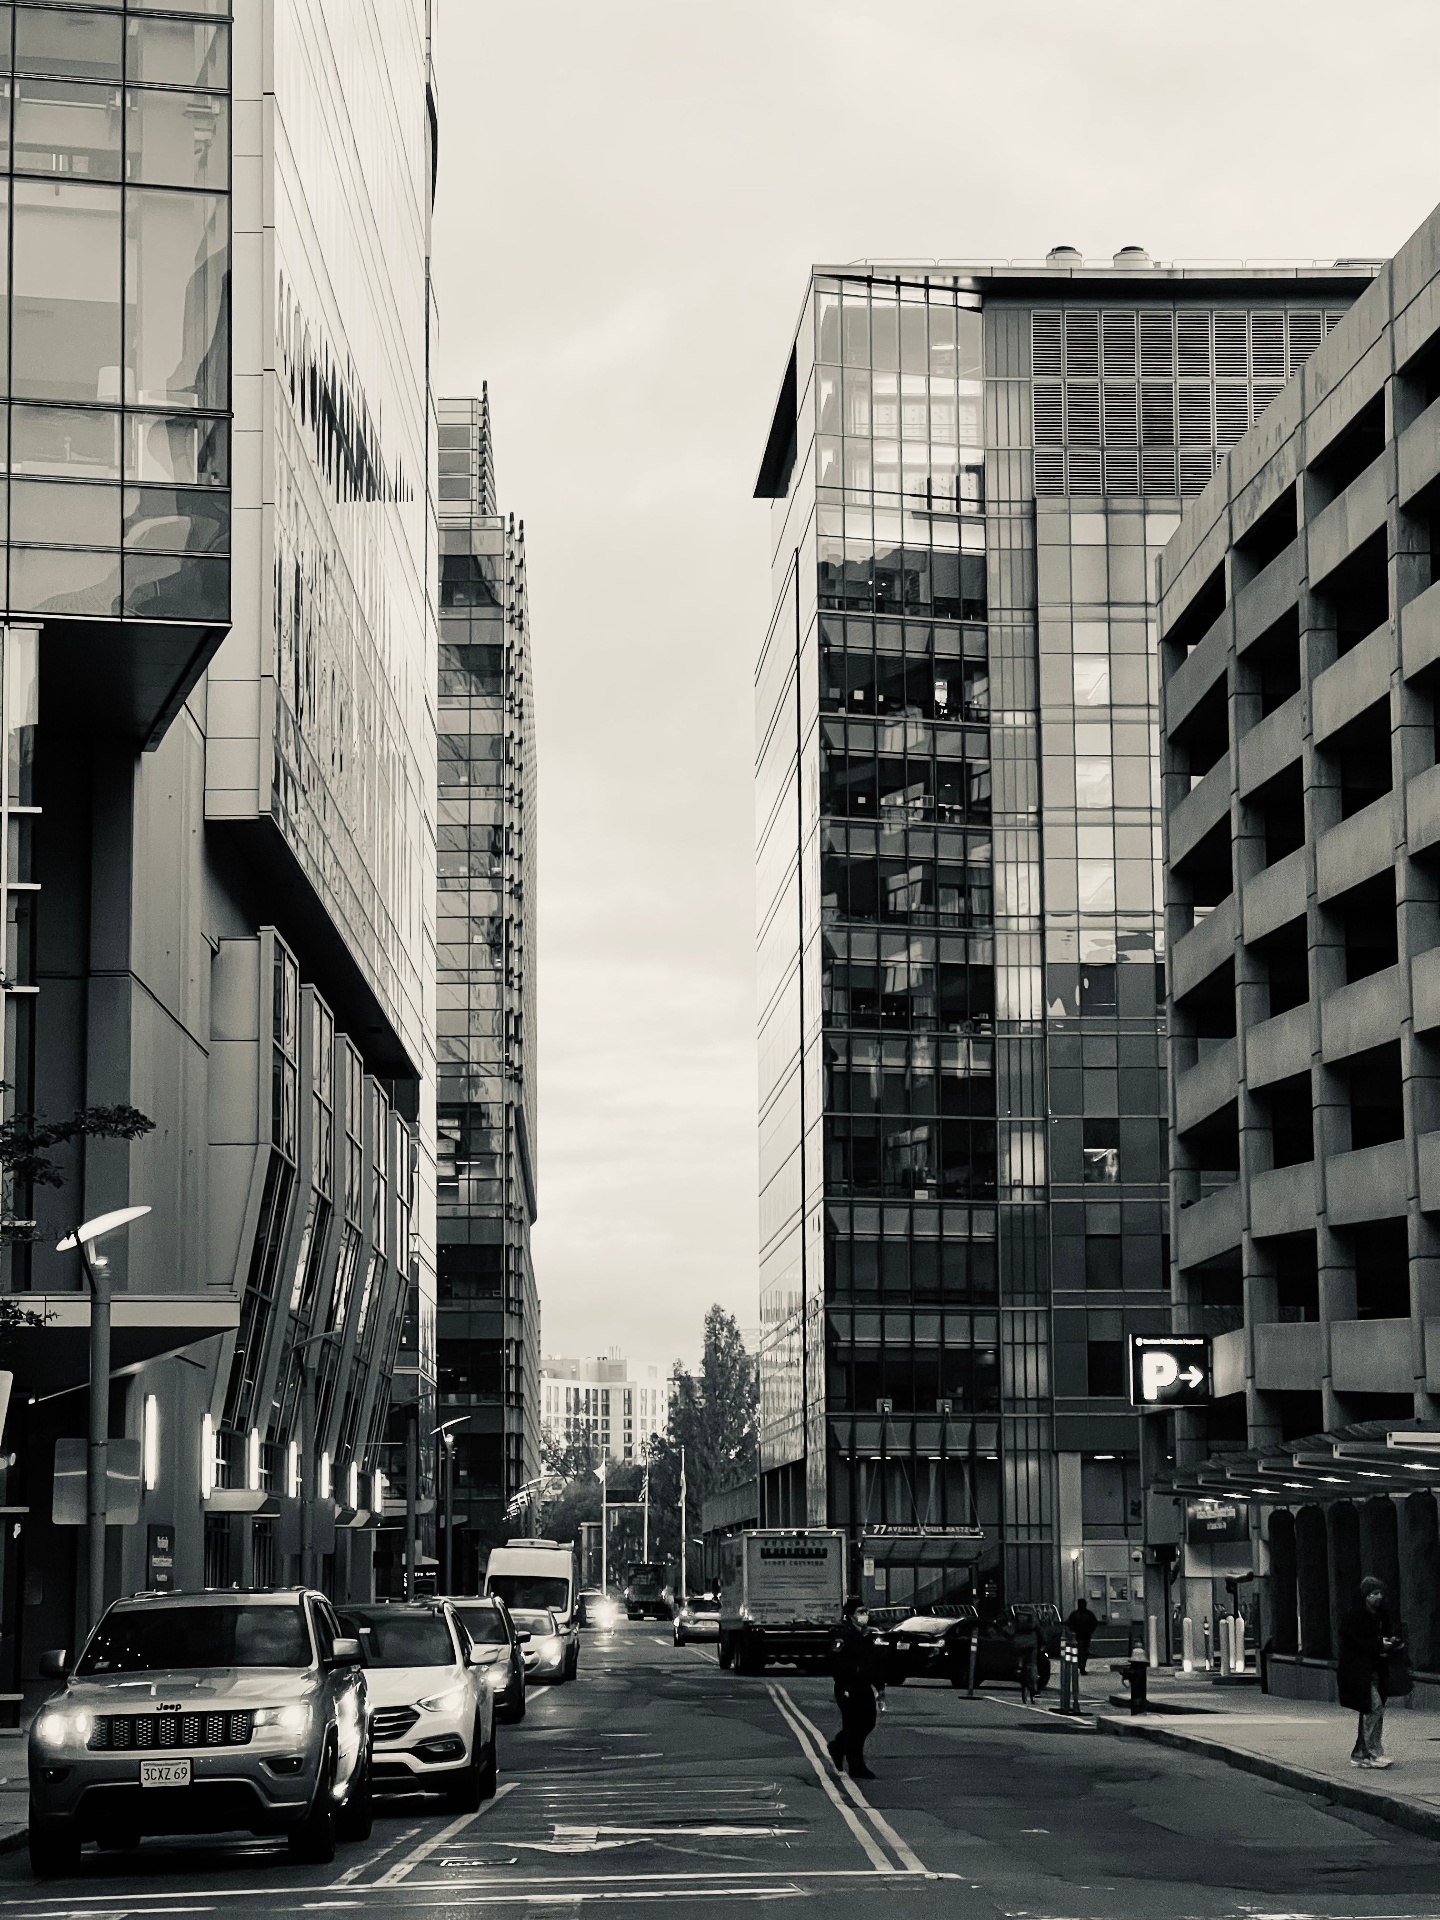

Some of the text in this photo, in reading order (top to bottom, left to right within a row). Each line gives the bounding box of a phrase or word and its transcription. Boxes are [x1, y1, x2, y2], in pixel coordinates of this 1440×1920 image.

[1142, 1351, 1178, 1400] P
[873, 1524, 887, 1535] 77
[156, 1703, 182, 1711] Jeep
[143, 1766, 188, 1781] 3CXZ 69
